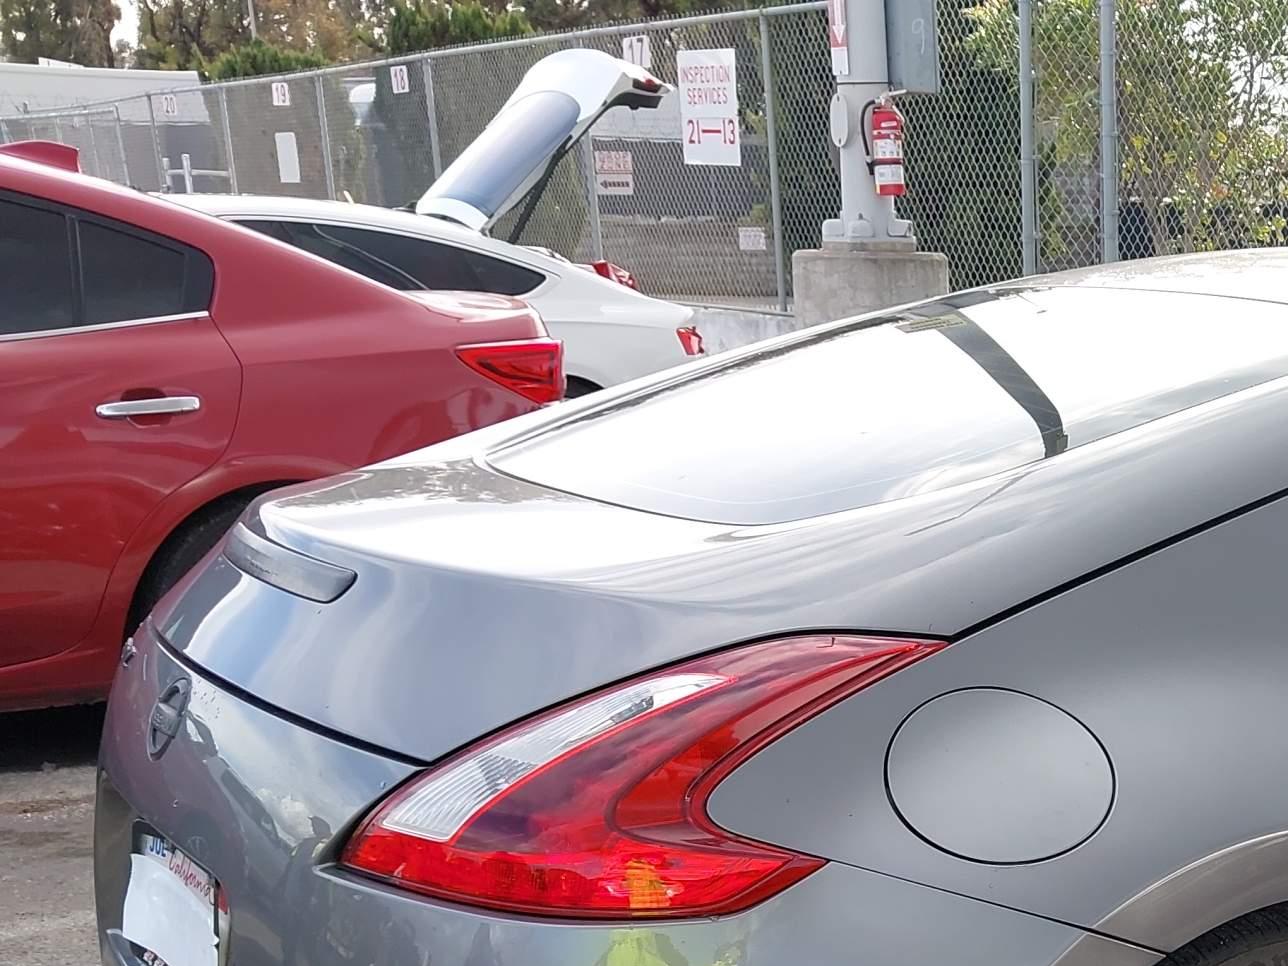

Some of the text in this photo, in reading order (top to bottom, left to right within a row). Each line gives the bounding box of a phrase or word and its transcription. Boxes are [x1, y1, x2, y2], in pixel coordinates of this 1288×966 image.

[628, 37, 645, 66] 17
[394, 67, 406, 91] 18
[681, 65, 730, 83] INSPECTION
[274, 83, 288, 104] 19
[687, 86, 728, 105] SERVICES
[164, 96, 176, 114] 20
[169, 852, 213, 899] California
